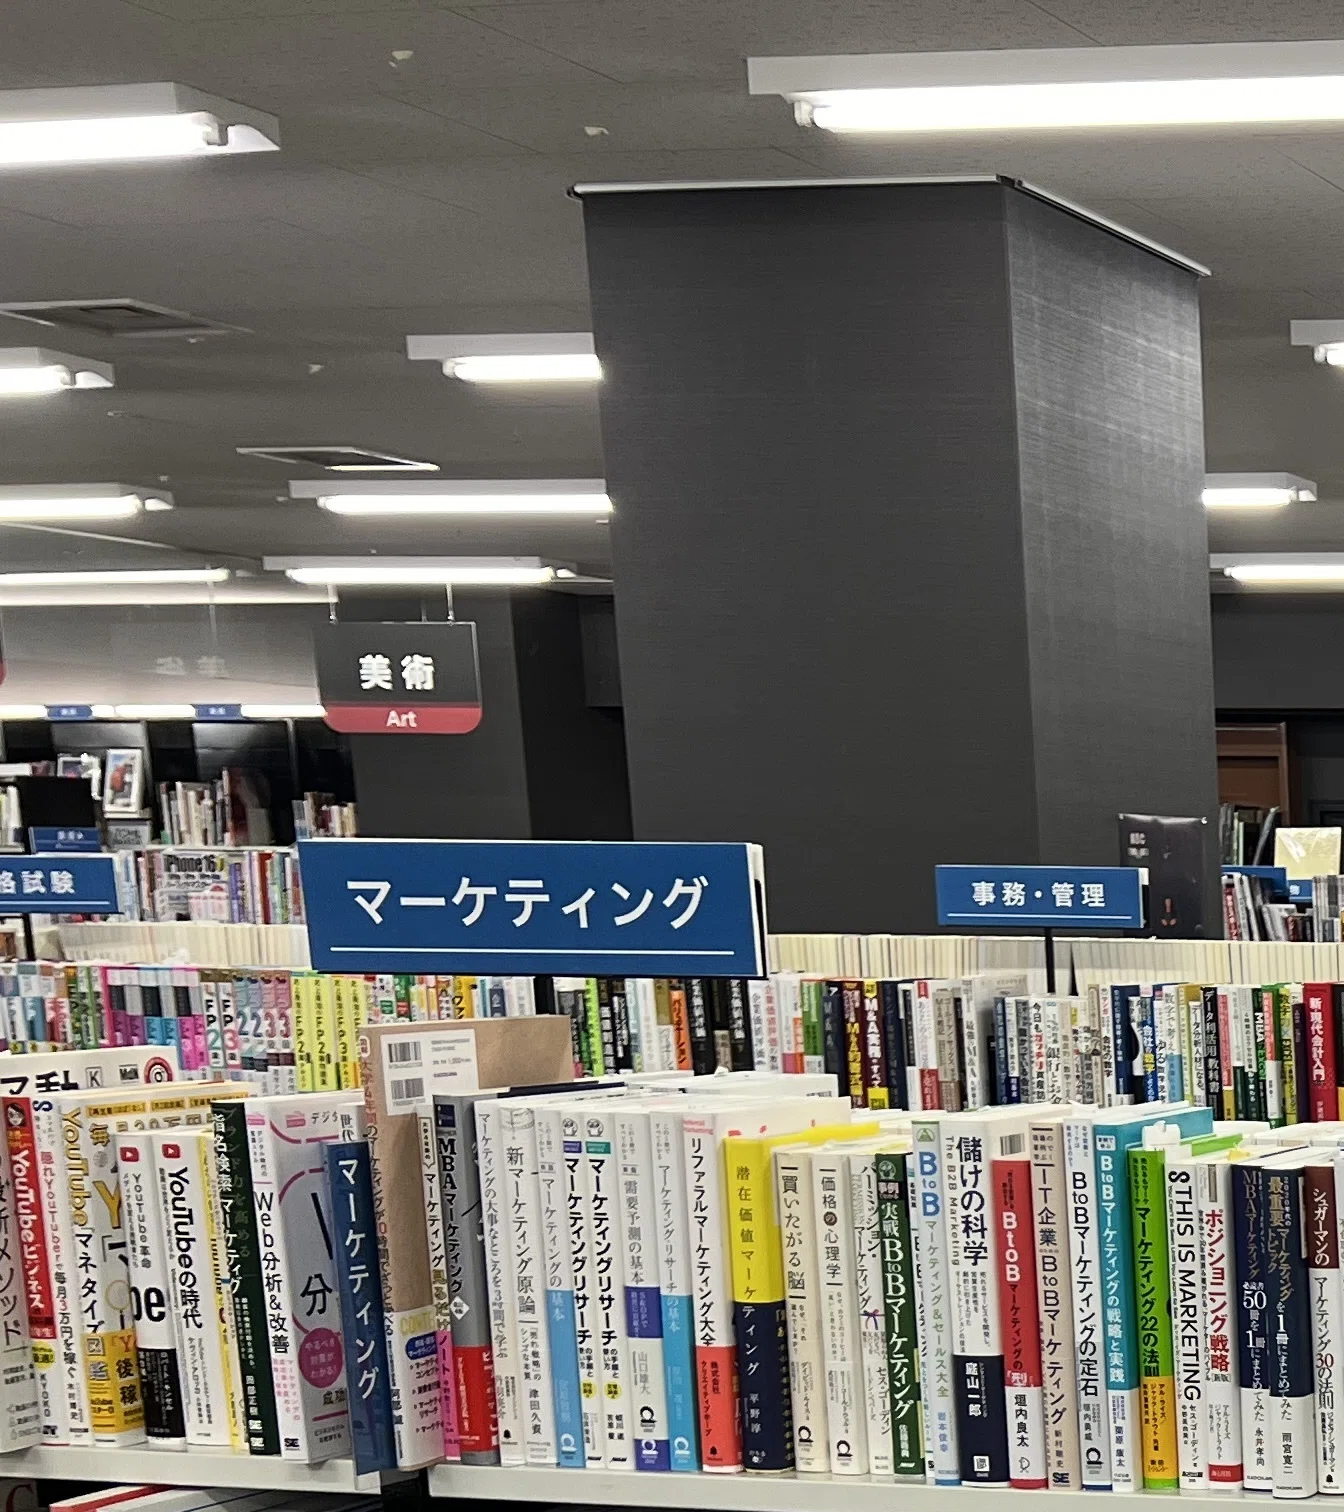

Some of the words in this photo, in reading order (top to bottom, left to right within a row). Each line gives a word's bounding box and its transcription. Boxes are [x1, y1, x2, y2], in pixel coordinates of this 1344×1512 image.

[359, 654, 435, 690] 美術
[386, 710, 416, 728] Art
[346, 875, 709, 929] マーケティング
[971, 881, 1105, 907] 事務・管理
[167, 1166, 203, 1329] YouTubeの時代
[338, 1159, 381, 1401] マーケティング
[506, 1145, 537, 1316] 新マーケティング原論
[564, 1158, 592, 1345] マーケティングリサーチ
[588, 1158, 618, 1345] マーケティングリサーチ
[690, 1136, 716, 1348] リファラルマーケティング大全
[956, 1136, 988, 1267] 儲けの科学
[1099, 1155, 1126, 1384] BtoBマーケティングの戦略と実践
[1173, 1191, 1194, 1244] THIS
[1178, 1247, 1196, 1266] IS
[1070, 1170, 1099, 1398] BtoBマーケティングの定石
[1179, 1270, 1200, 1400] MARKETING
[1204, 1209, 1231, 1373] ポジショニング戦略
